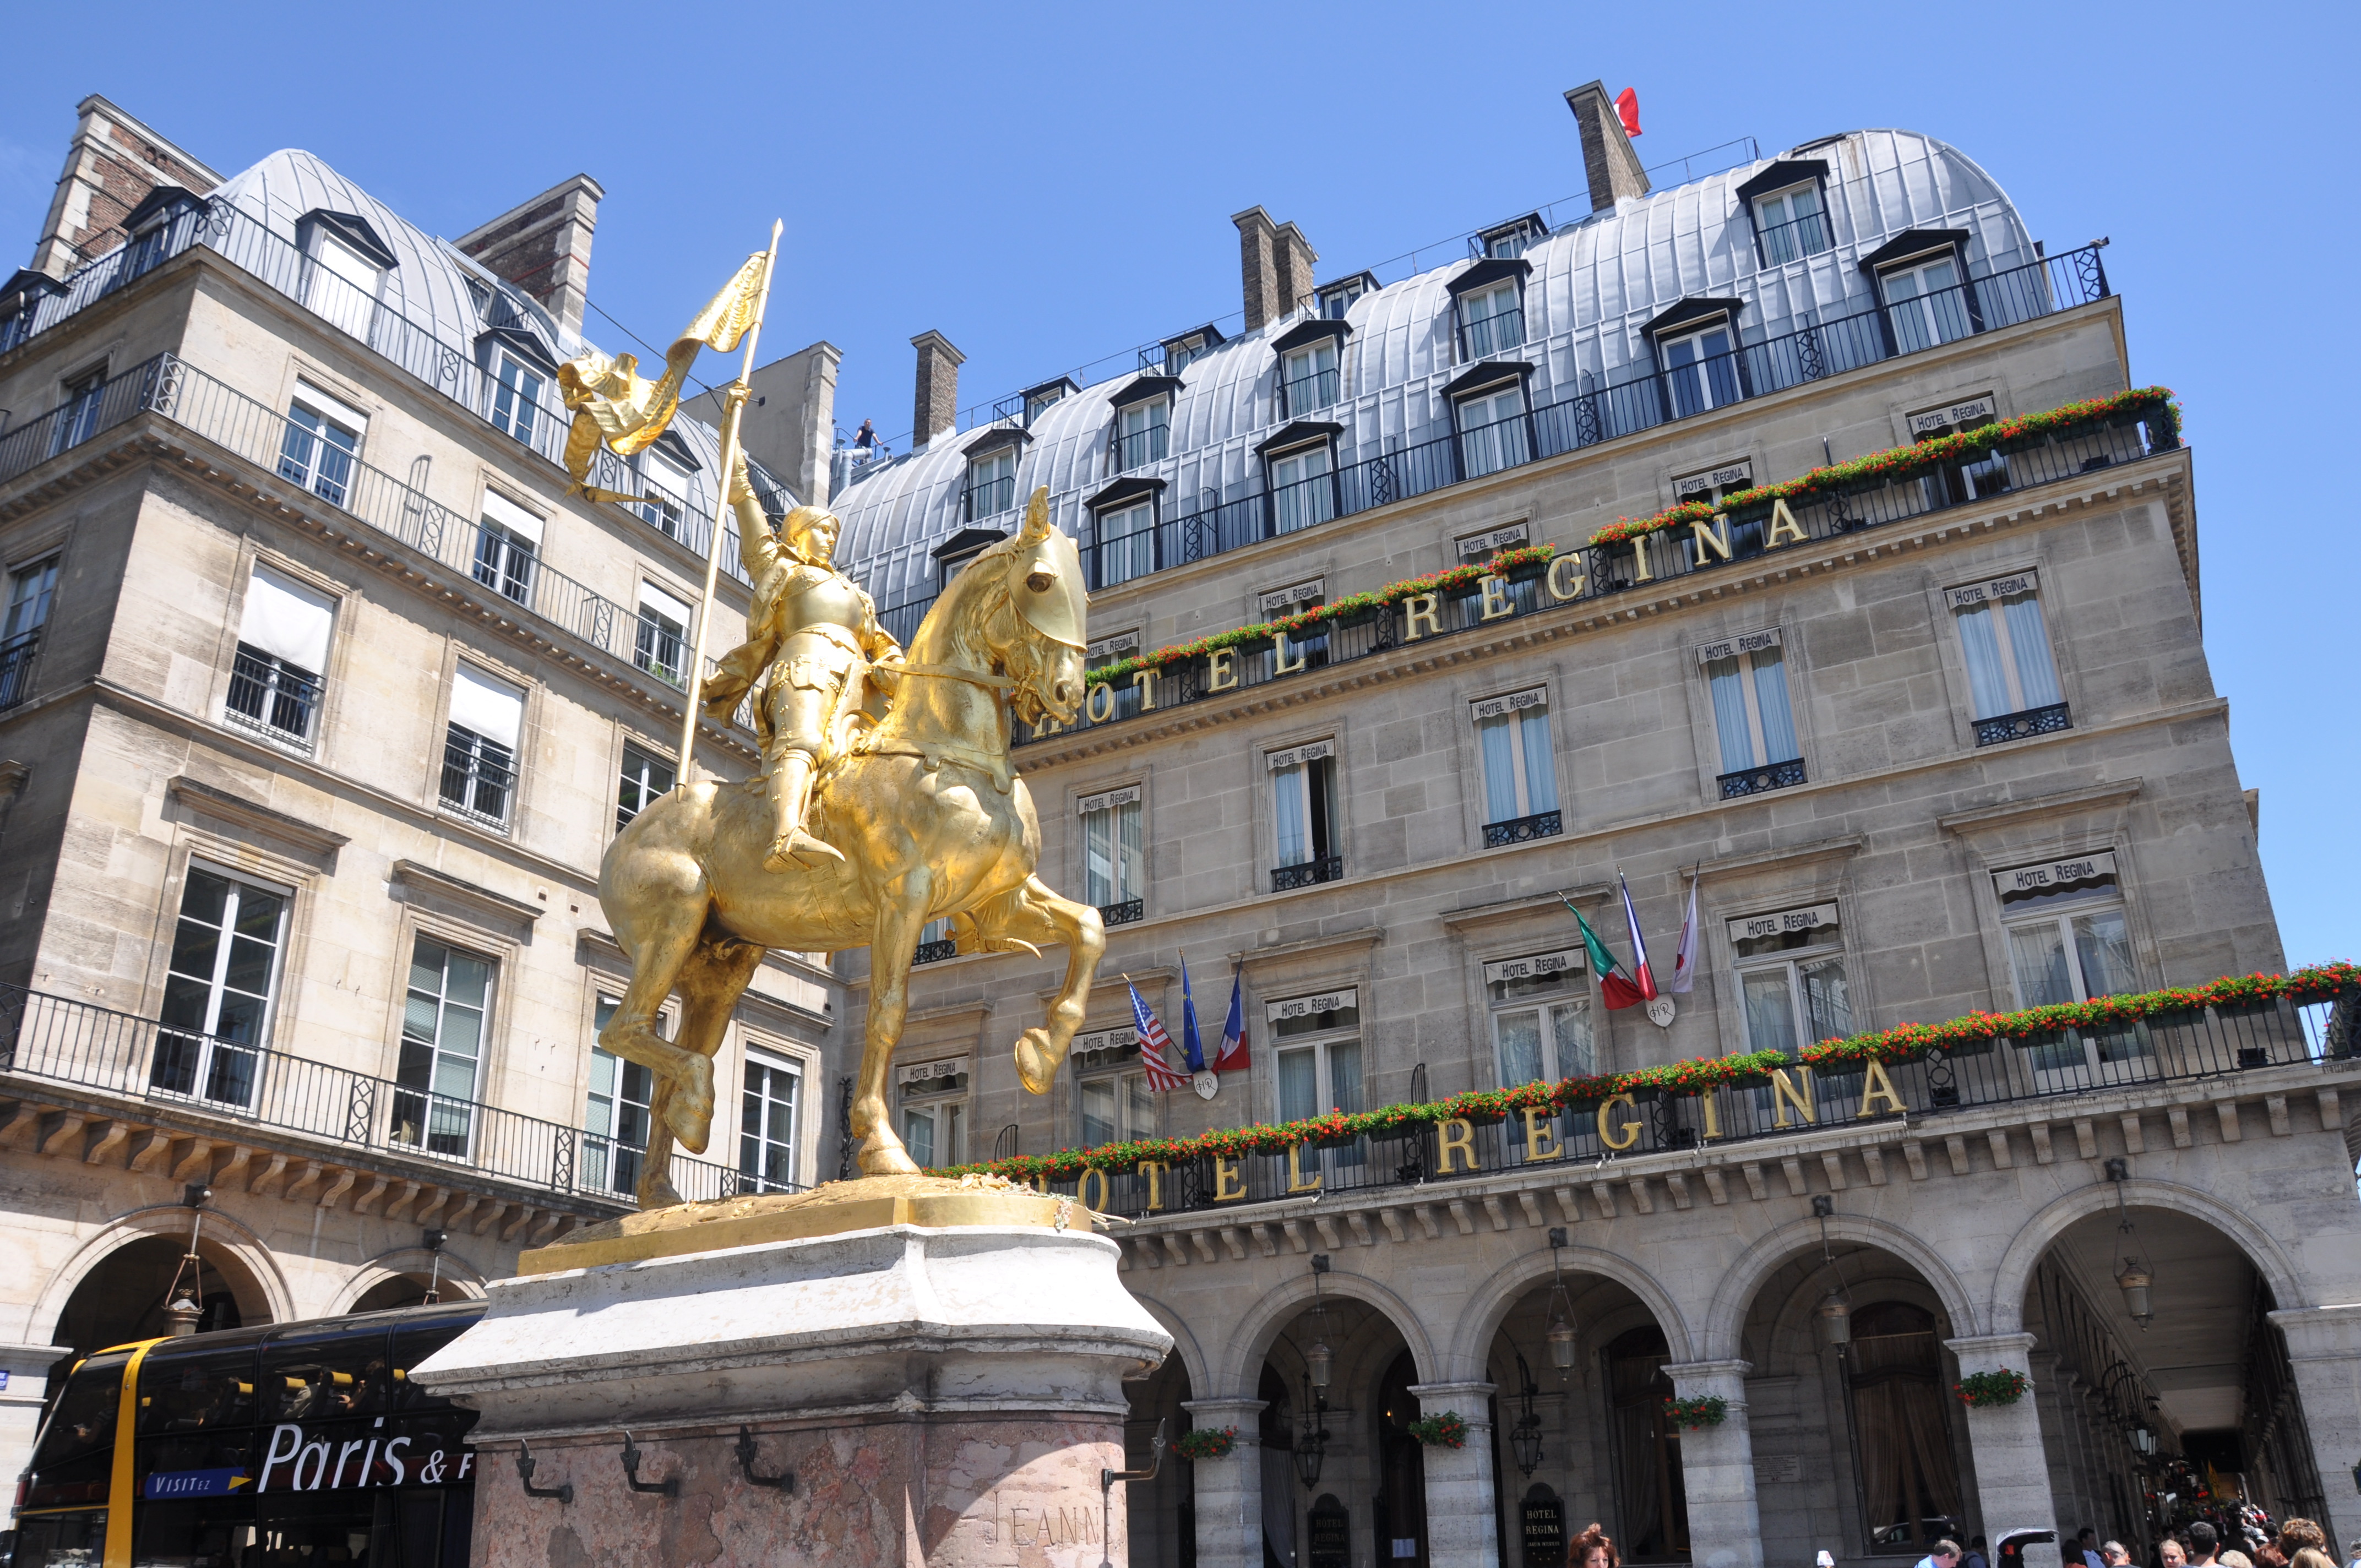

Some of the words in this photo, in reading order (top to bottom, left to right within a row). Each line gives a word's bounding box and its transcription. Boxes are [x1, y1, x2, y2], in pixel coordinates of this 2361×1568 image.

[1917, 413, 1946, 429] HOTEL
[1951, 402, 1986, 421] REGINA
[1680, 478, 1707, 493] HOTEL
[1712, 467, 1744, 485] REGINA
[1464, 538, 1488, 553] HOTEL
[1493, 529, 1521, 545] REGINA
[1402, 498, 1810, 641] REGINA
[1266, 594, 1288, 608] HOTEL
[1292, 584, 1319, 601] REGINA
[1955, 587, 1985, 604] HOTEL
[1991, 577, 2028, 596] REGINA
[1085, 644, 1105, 658] HOTEL
[1109, 636, 1133, 651] REGINA
[1705, 643, 1734, 659] HOTEL
[1738, 633, 1772, 651] REGINA
[1478, 701, 1504, 716] HOTEL
[1509, 693, 1539, 709] REGINA
[1273, 752, 1296, 767] HOTEL
[1301, 744, 1328, 760] REGINA
[1084, 798, 1105, 811] HOTEL
[1109, 790, 1133, 805] REGINA
[2015, 871, 2049, 887] HOTEL
[2054, 861, 2095, 880] REGINA
[1747, 919, 1777, 935] HOTEL
[1783, 911, 1819, 929] REGINA
[1502, 963, 1530, 978] HOTEL
[1535, 955, 1566, 972] REGINA
[1281, 1003, 1305, 1016] HOTEL
[1312, 995, 1340, 1011] REGINA
[1083, 1037, 1105, 1050] HOTEL
[1109, 1031, 1135, 1046] REGINA
[910, 1068, 929, 1080] HOTEL
[933, 1061, 956, 1076] REGINA
[1018, 1142, 1322, 1213] OTEL
[1433, 1058, 1909, 1174] REGINA
[257, 1417, 411, 1493] Paris
[420, 1450, 448, 1484] &
[156, 1477, 210, 1493] VISITEZ
[1315, 1533, 1345, 1542] REGINA
[1526, 1525, 1559, 1534] REGINA
